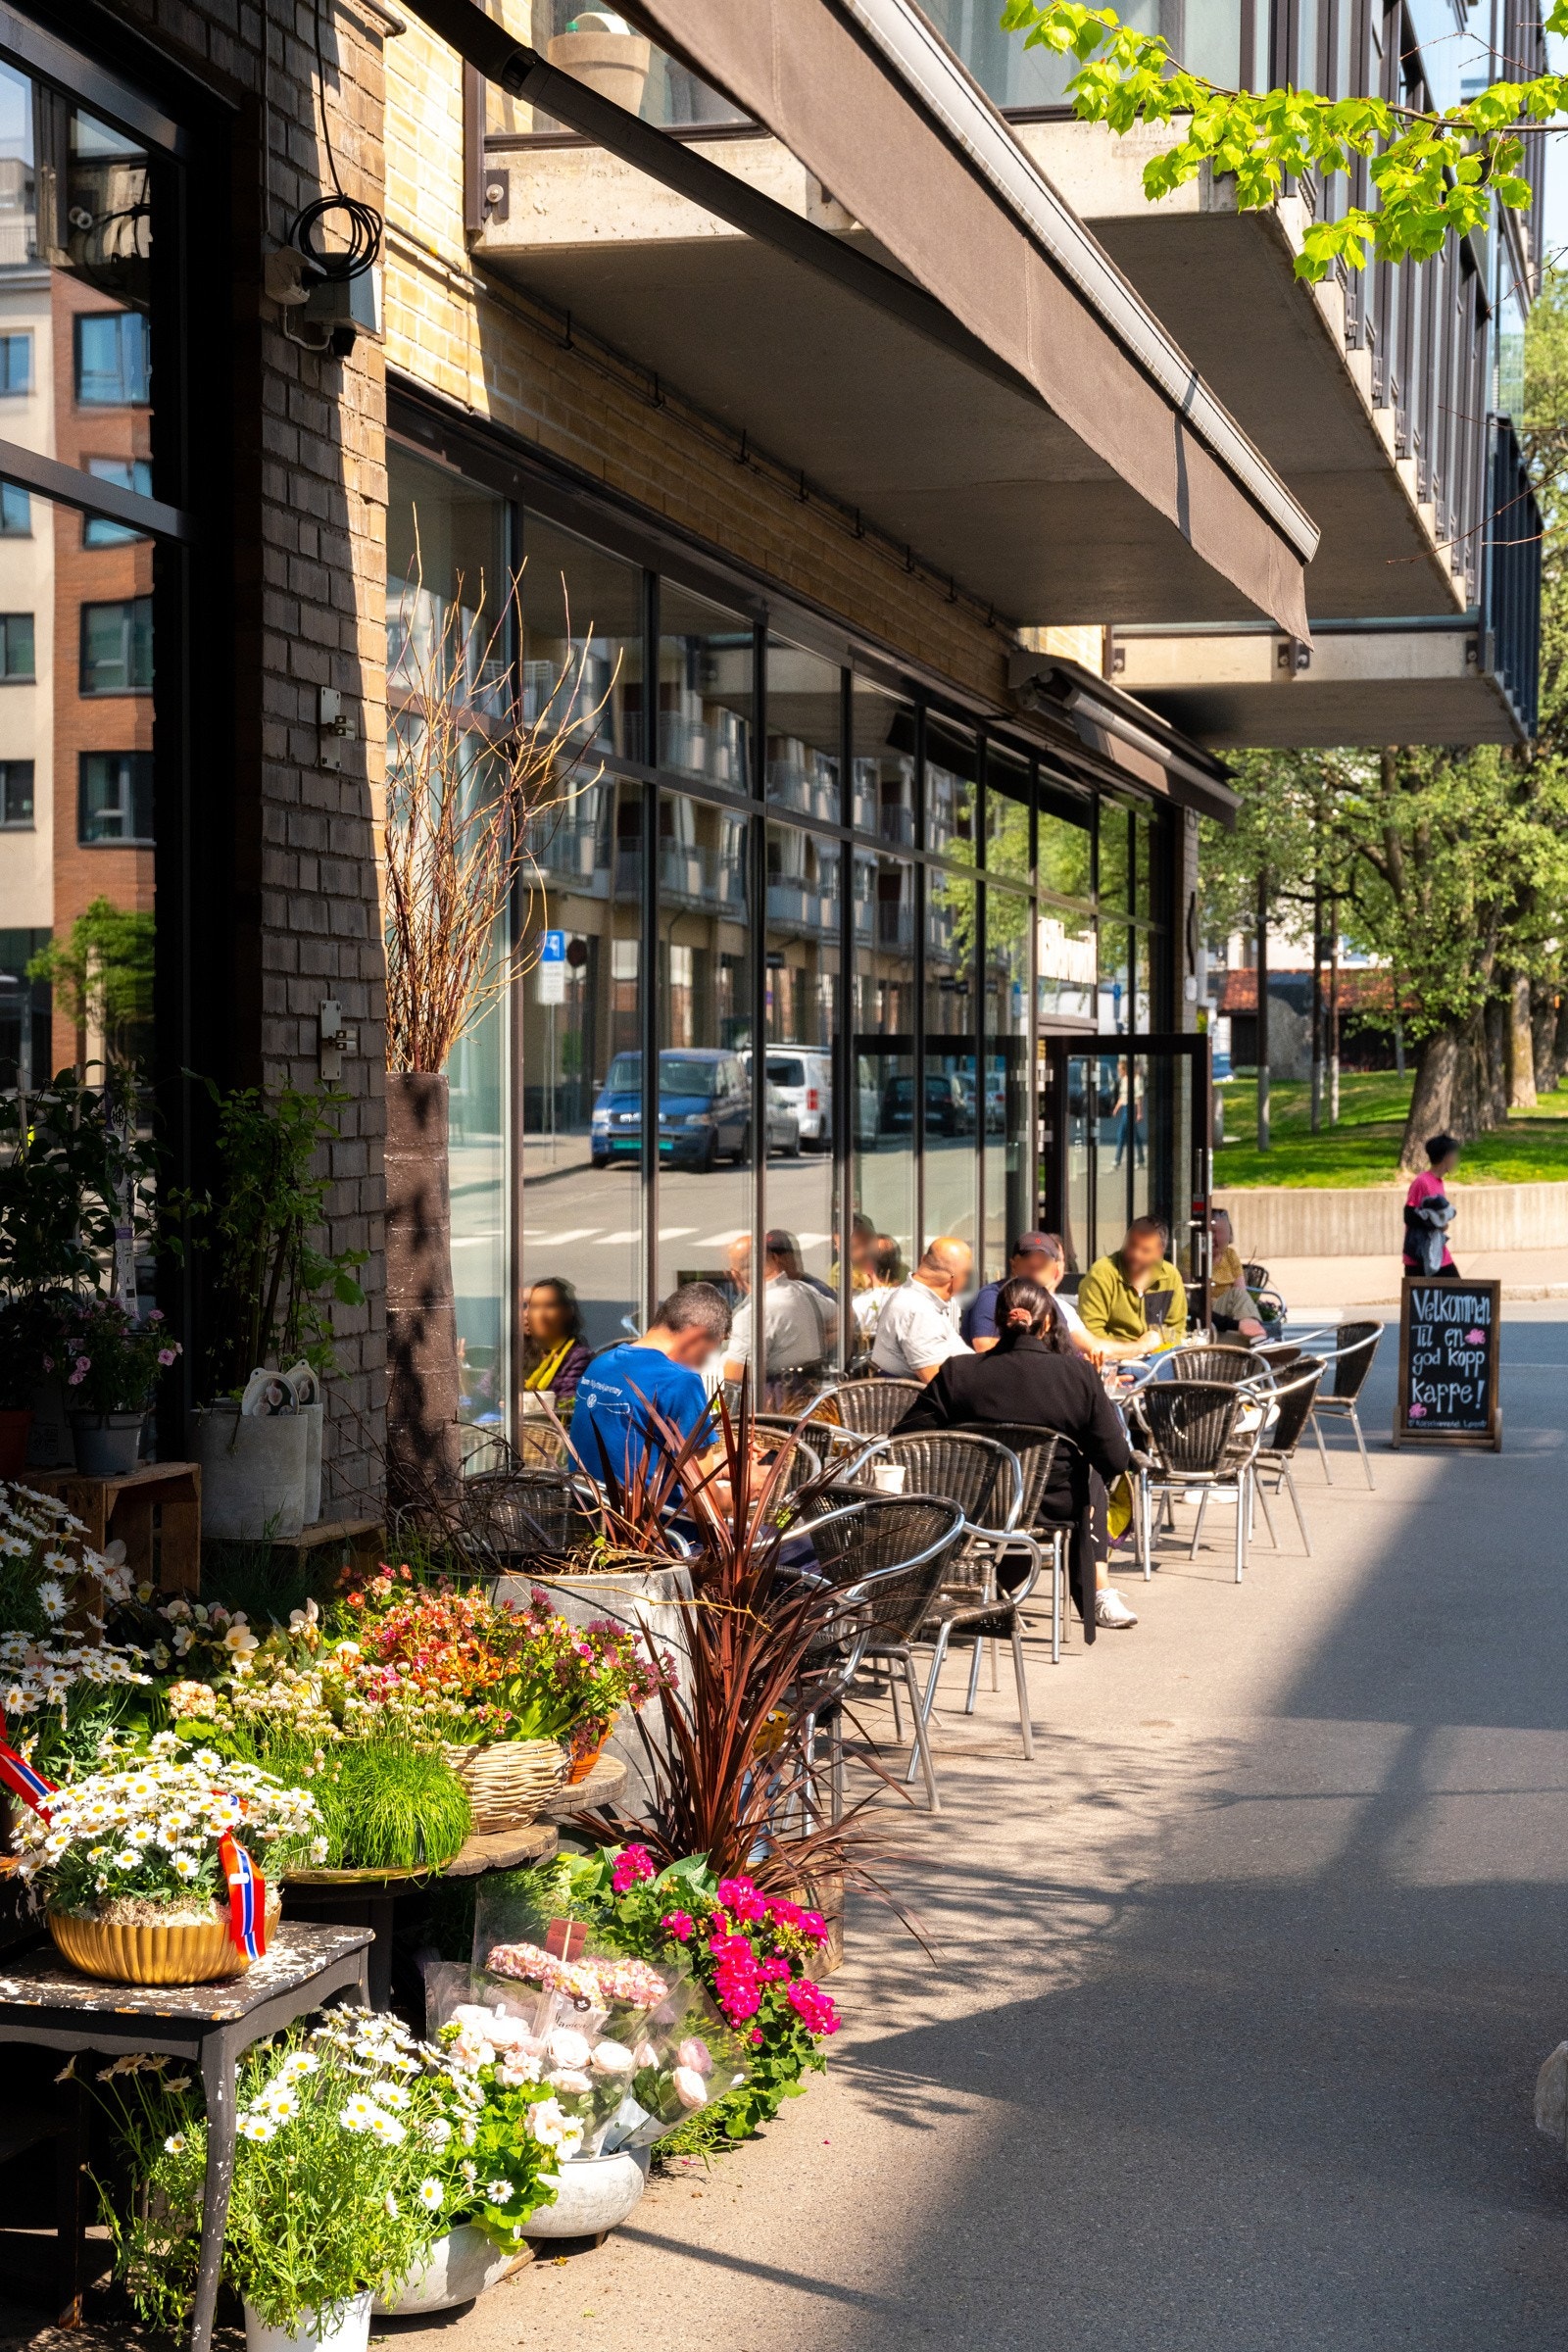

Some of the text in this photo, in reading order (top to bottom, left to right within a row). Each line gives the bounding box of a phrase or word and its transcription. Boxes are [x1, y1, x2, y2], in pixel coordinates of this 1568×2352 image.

[1412, 1289, 1491, 1324] Velkommen
[1411, 1325, 1465, 1348] Til en
[1412, 1348, 1441, 1376] god
